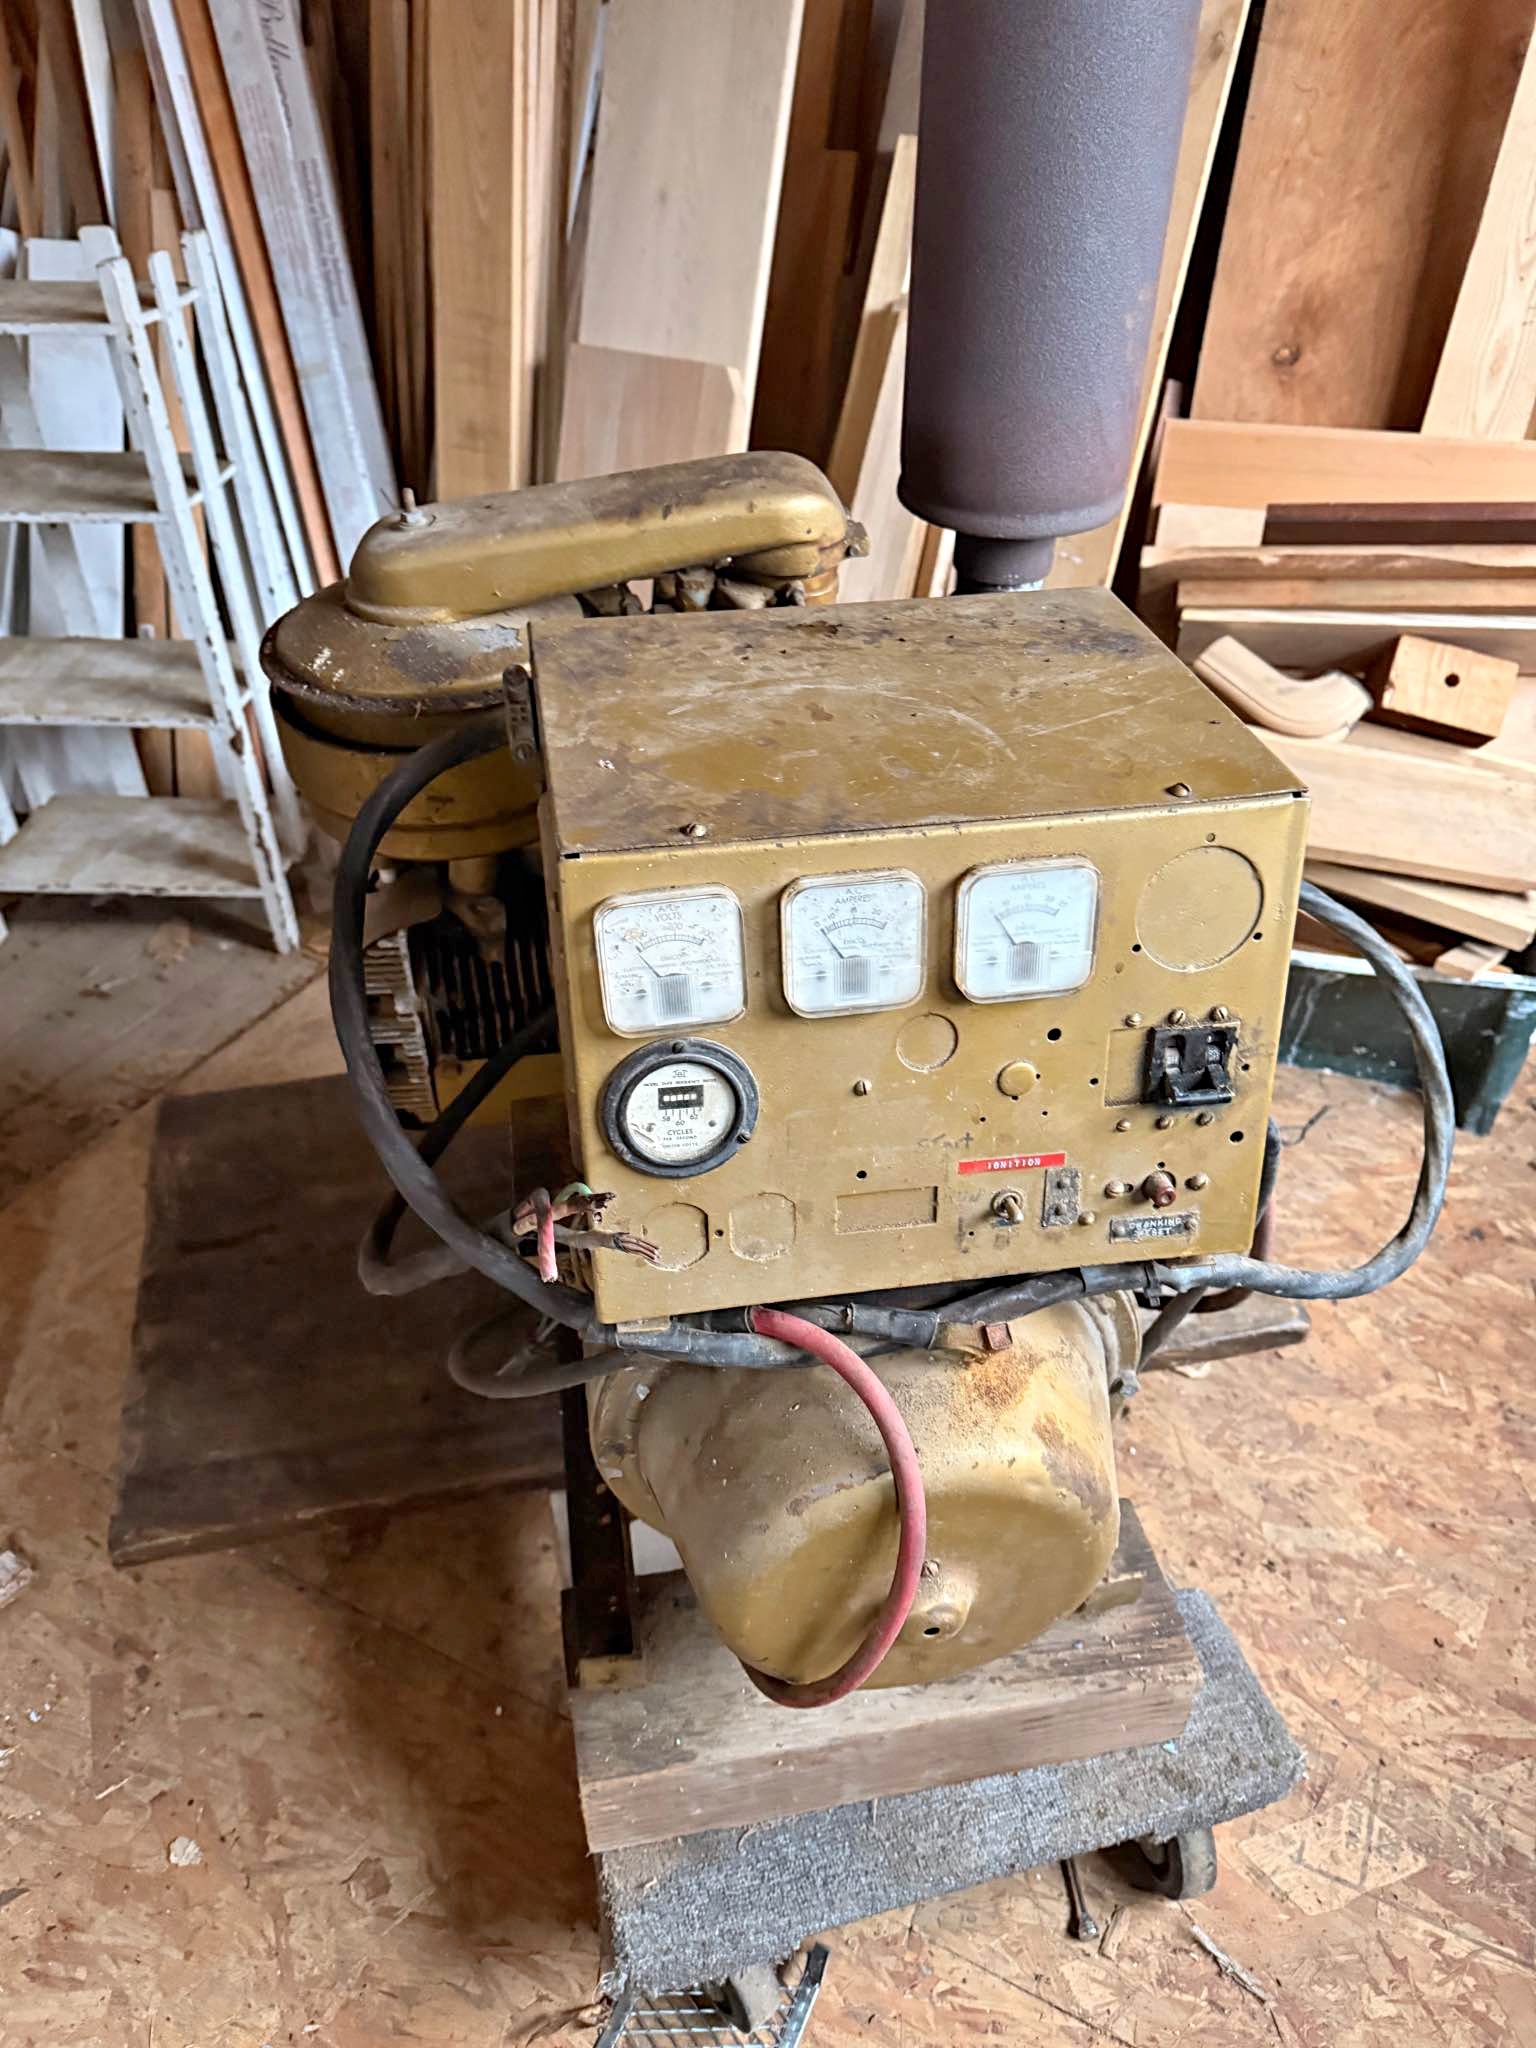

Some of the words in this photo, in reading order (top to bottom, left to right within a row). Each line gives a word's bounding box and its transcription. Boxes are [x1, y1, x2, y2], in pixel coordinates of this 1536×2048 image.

[835, 894, 873, 904] AMPERES
[655, 912, 682, 922] VOLTS
[667, 1128, 694, 1136] CYCLES
[986, 1157, 1042, 1170] IGNITION
[1128, 1217, 1183, 1231] CRANKING
